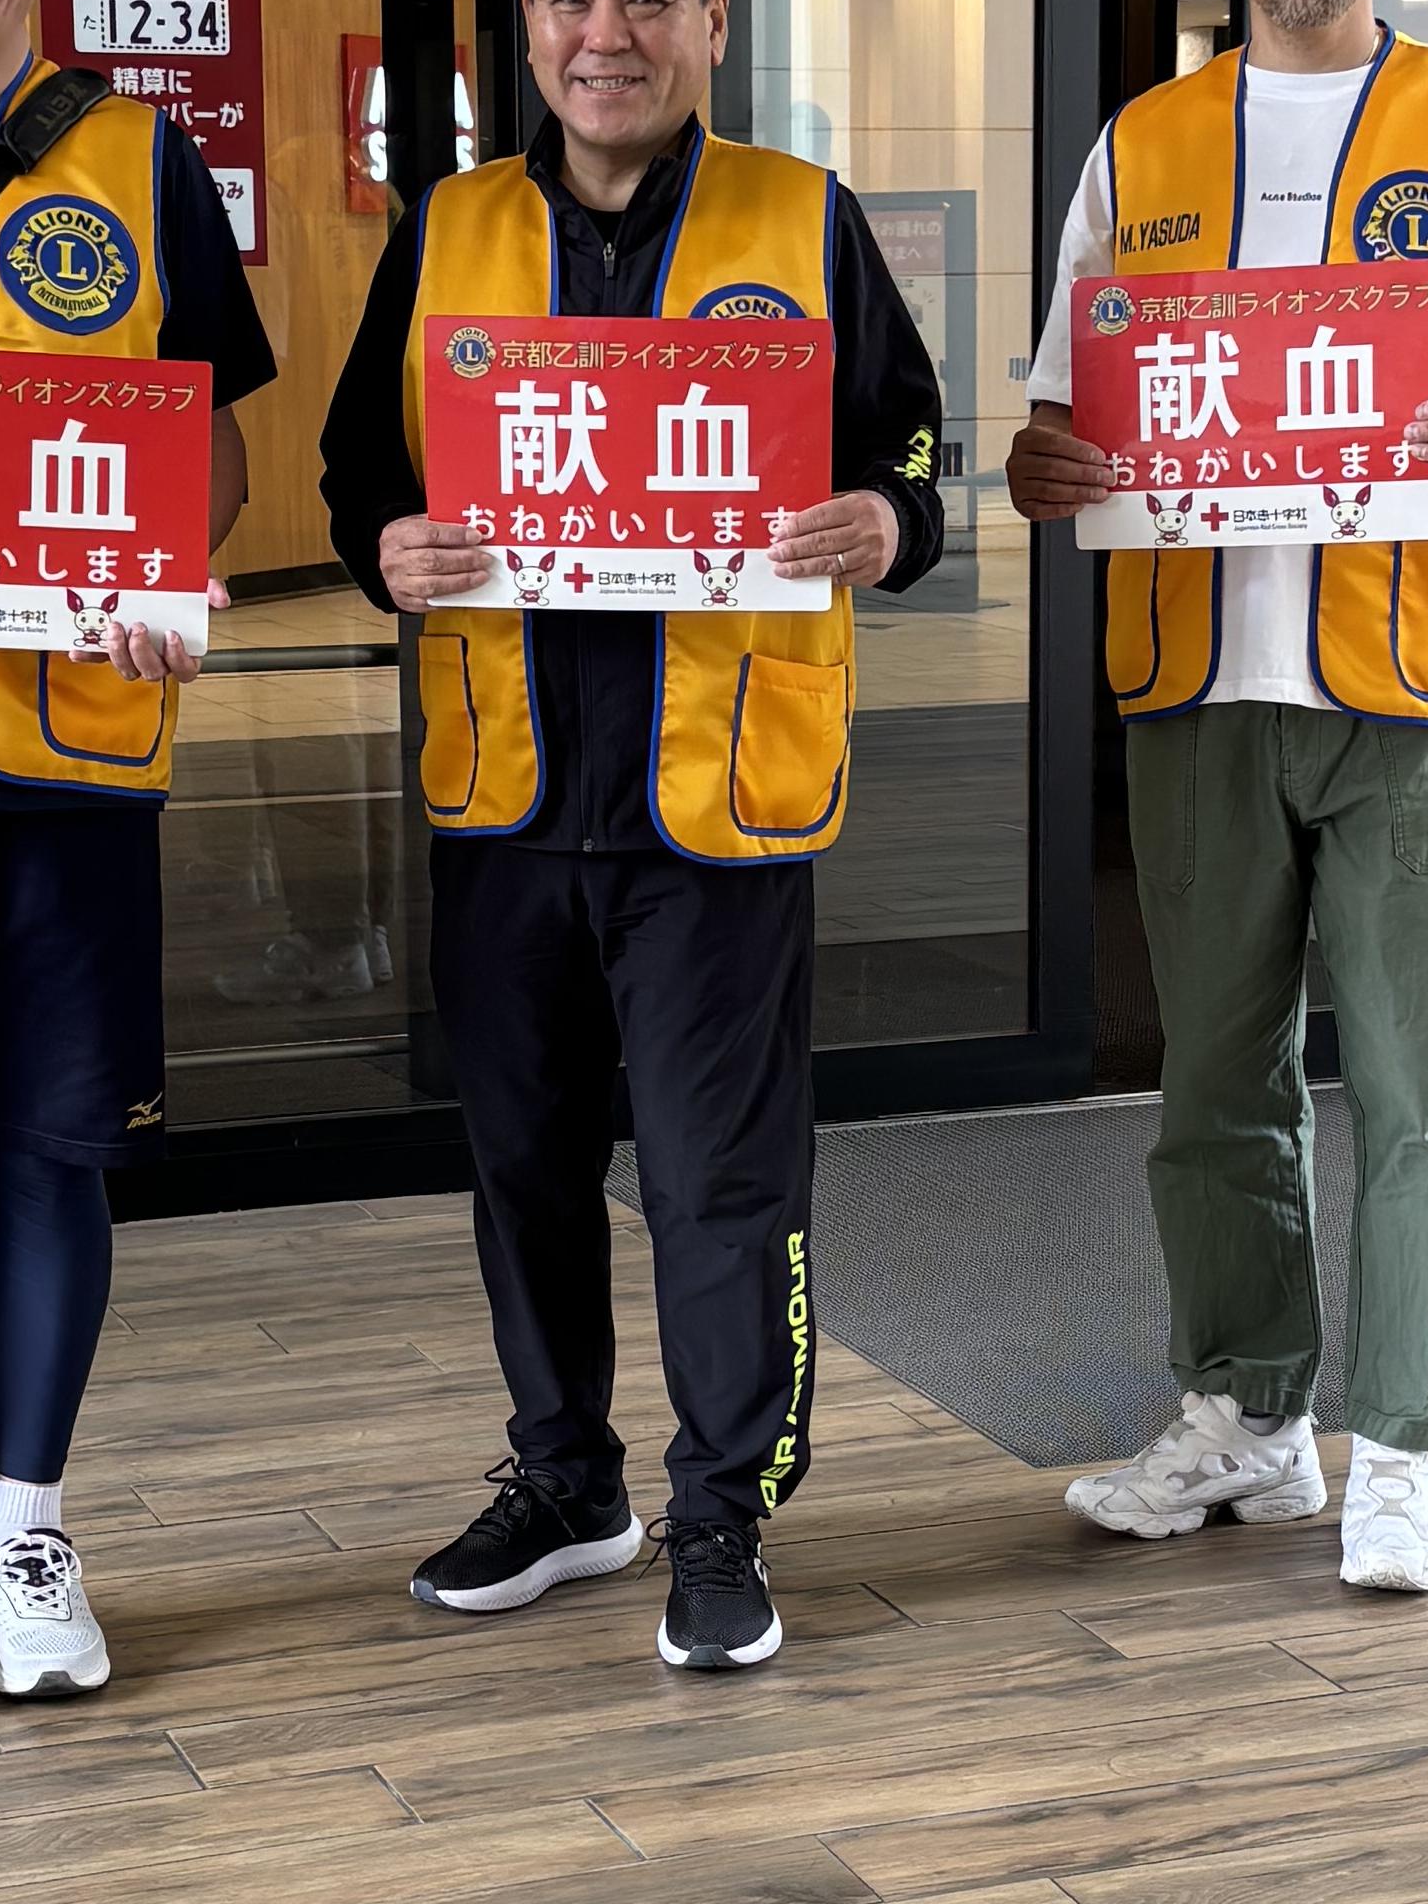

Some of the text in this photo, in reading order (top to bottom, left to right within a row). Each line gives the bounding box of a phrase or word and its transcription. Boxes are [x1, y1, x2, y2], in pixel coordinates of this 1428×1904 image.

[82, 14, 98, 31] た
[112, 66, 193, 96] 精算に
[167, 101, 245, 128] バーが
[35, 209, 109, 239] LIONS
[1119, 211, 1201, 256] M.YASUDA
[55, 239, 89, 282] L
[714, 297, 783, 319] LIONS
[499, 339, 818, 371] 京都乙訓ライオンズクラブ
[1133, 324, 1385, 444] 献血
[494, 379, 760, 496] 献血
[1108, 440, 1416, 489] おねがいします
[460, 503, 799, 544] おねがいします
